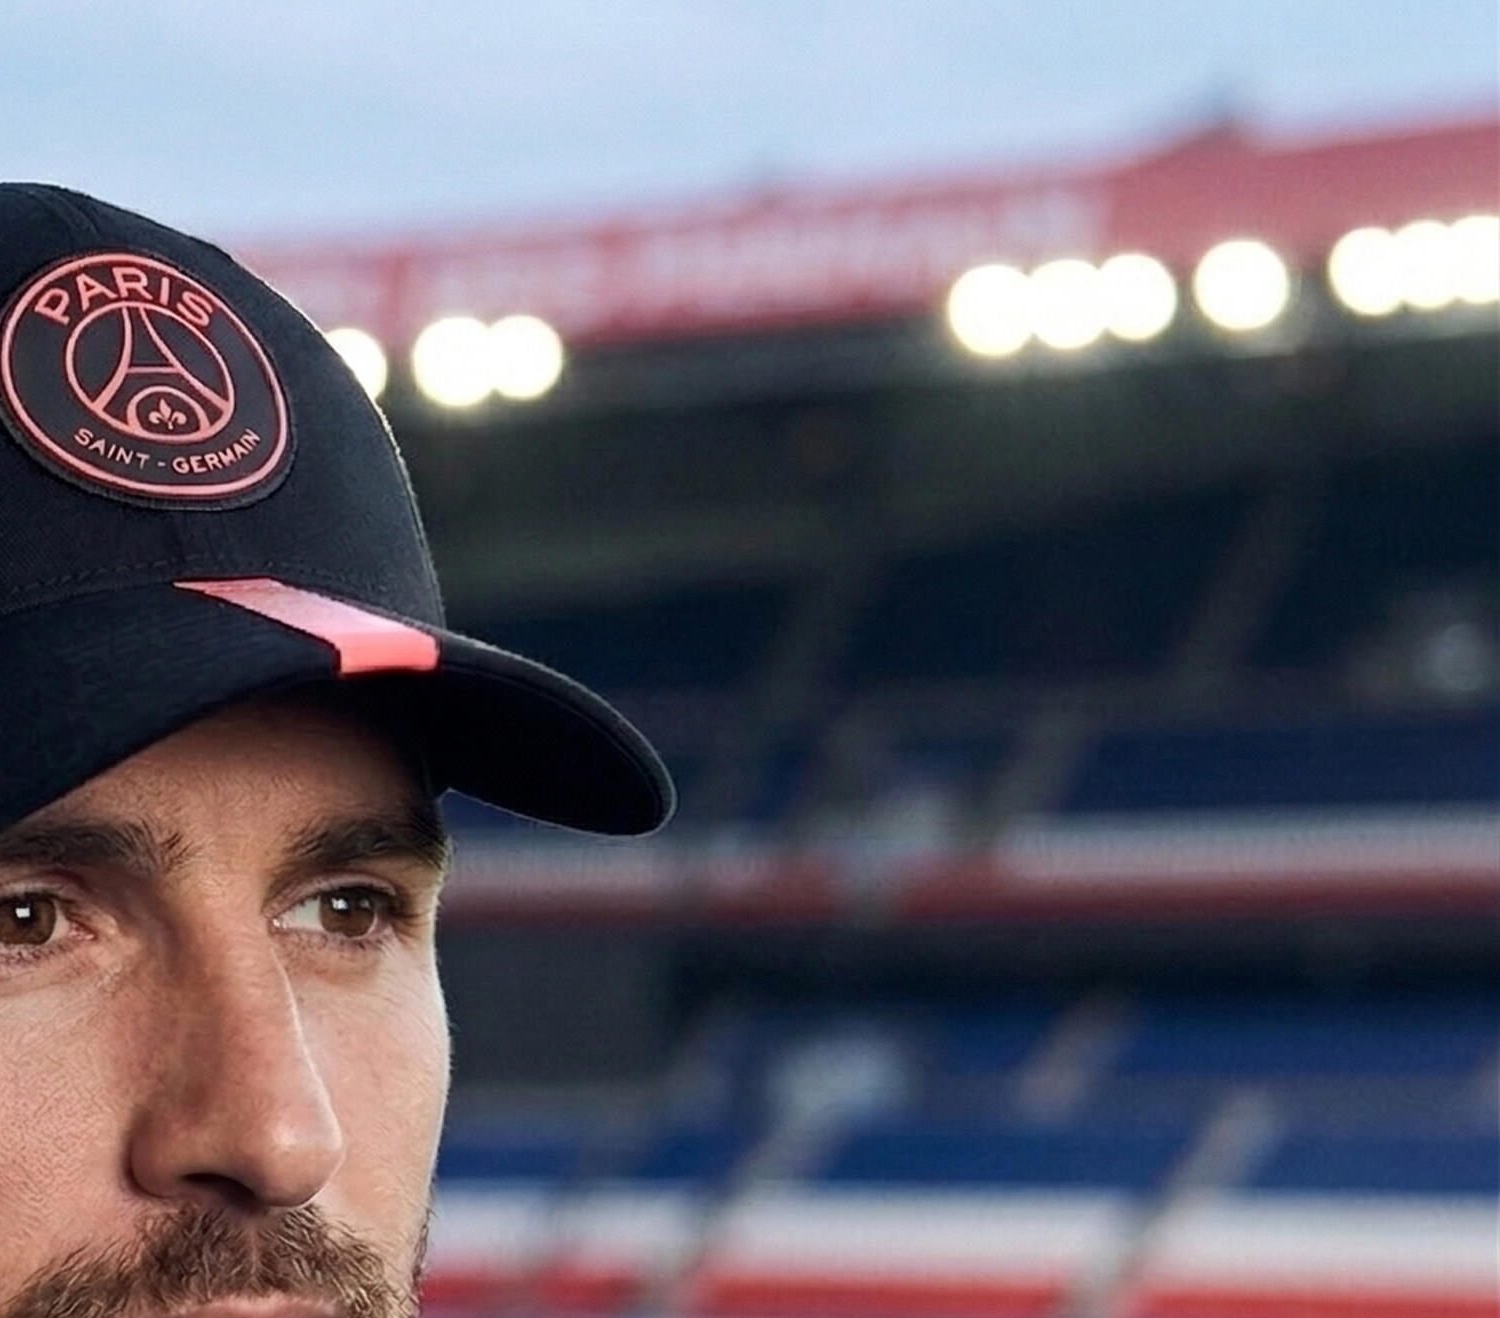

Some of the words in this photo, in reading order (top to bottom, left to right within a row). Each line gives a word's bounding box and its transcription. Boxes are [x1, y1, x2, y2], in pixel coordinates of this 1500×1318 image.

[34, 265, 215, 328] PARIS
[73, 427, 150, 470] SAINT
[171, 428, 261, 474] GERMAIN
